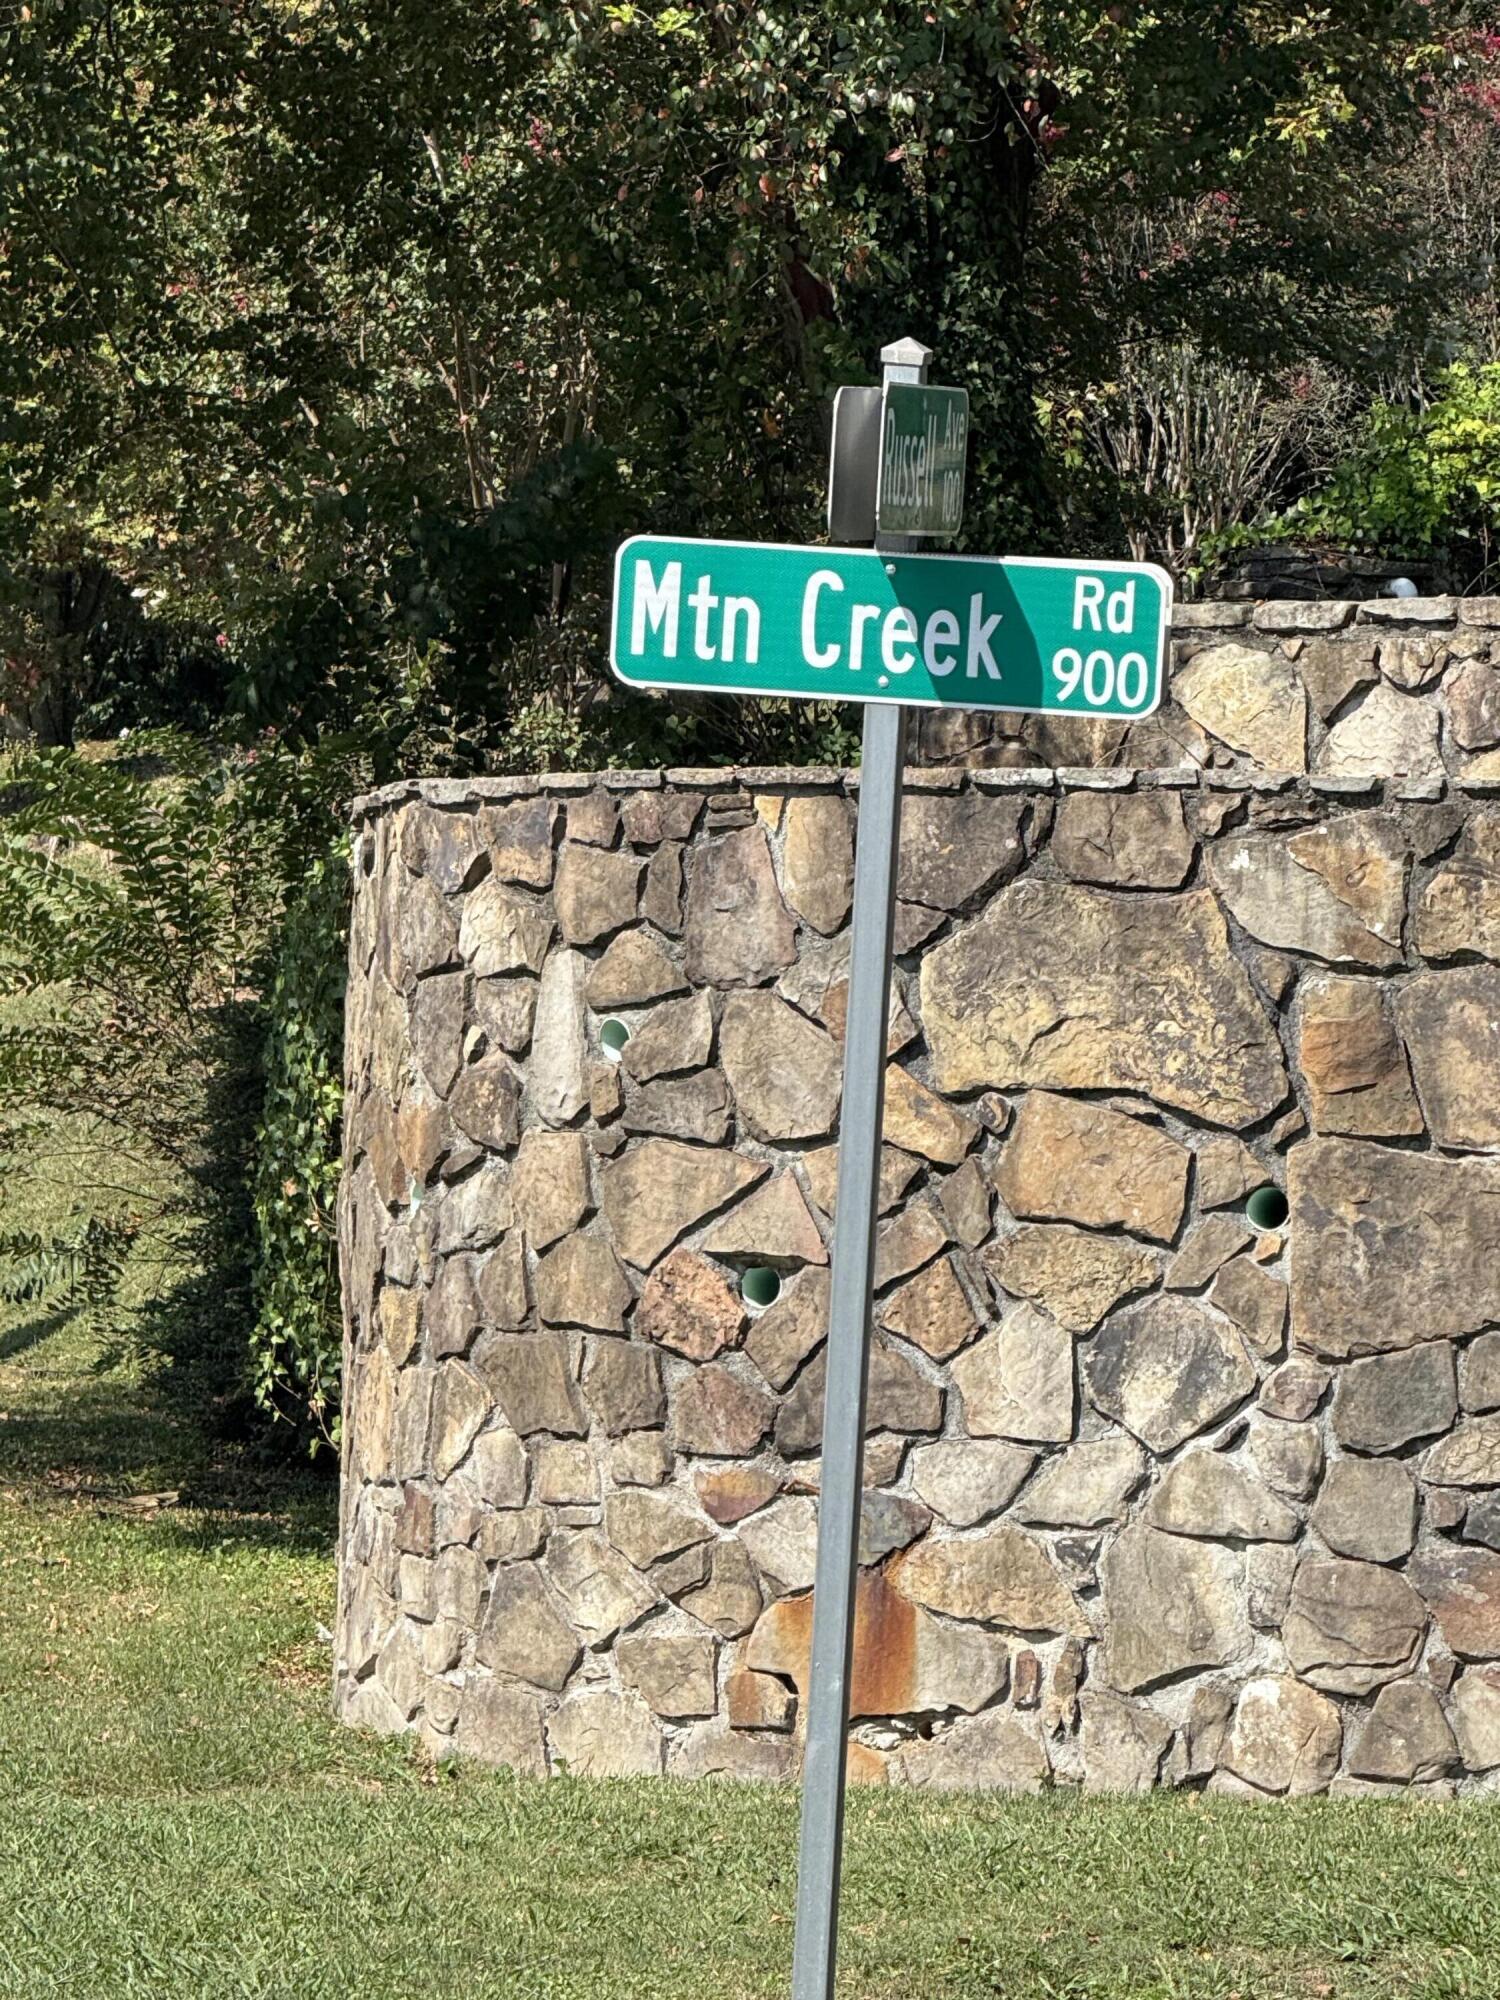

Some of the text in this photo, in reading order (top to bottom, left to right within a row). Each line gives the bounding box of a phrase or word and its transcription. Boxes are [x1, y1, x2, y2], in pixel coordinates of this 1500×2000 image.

[882, 399, 966, 507] Russell Ave
[941, 470, 961, 523] 100
[630, 559, 1136, 681] Mtn Creek Rd
[1051, 647, 1149, 709] 900
